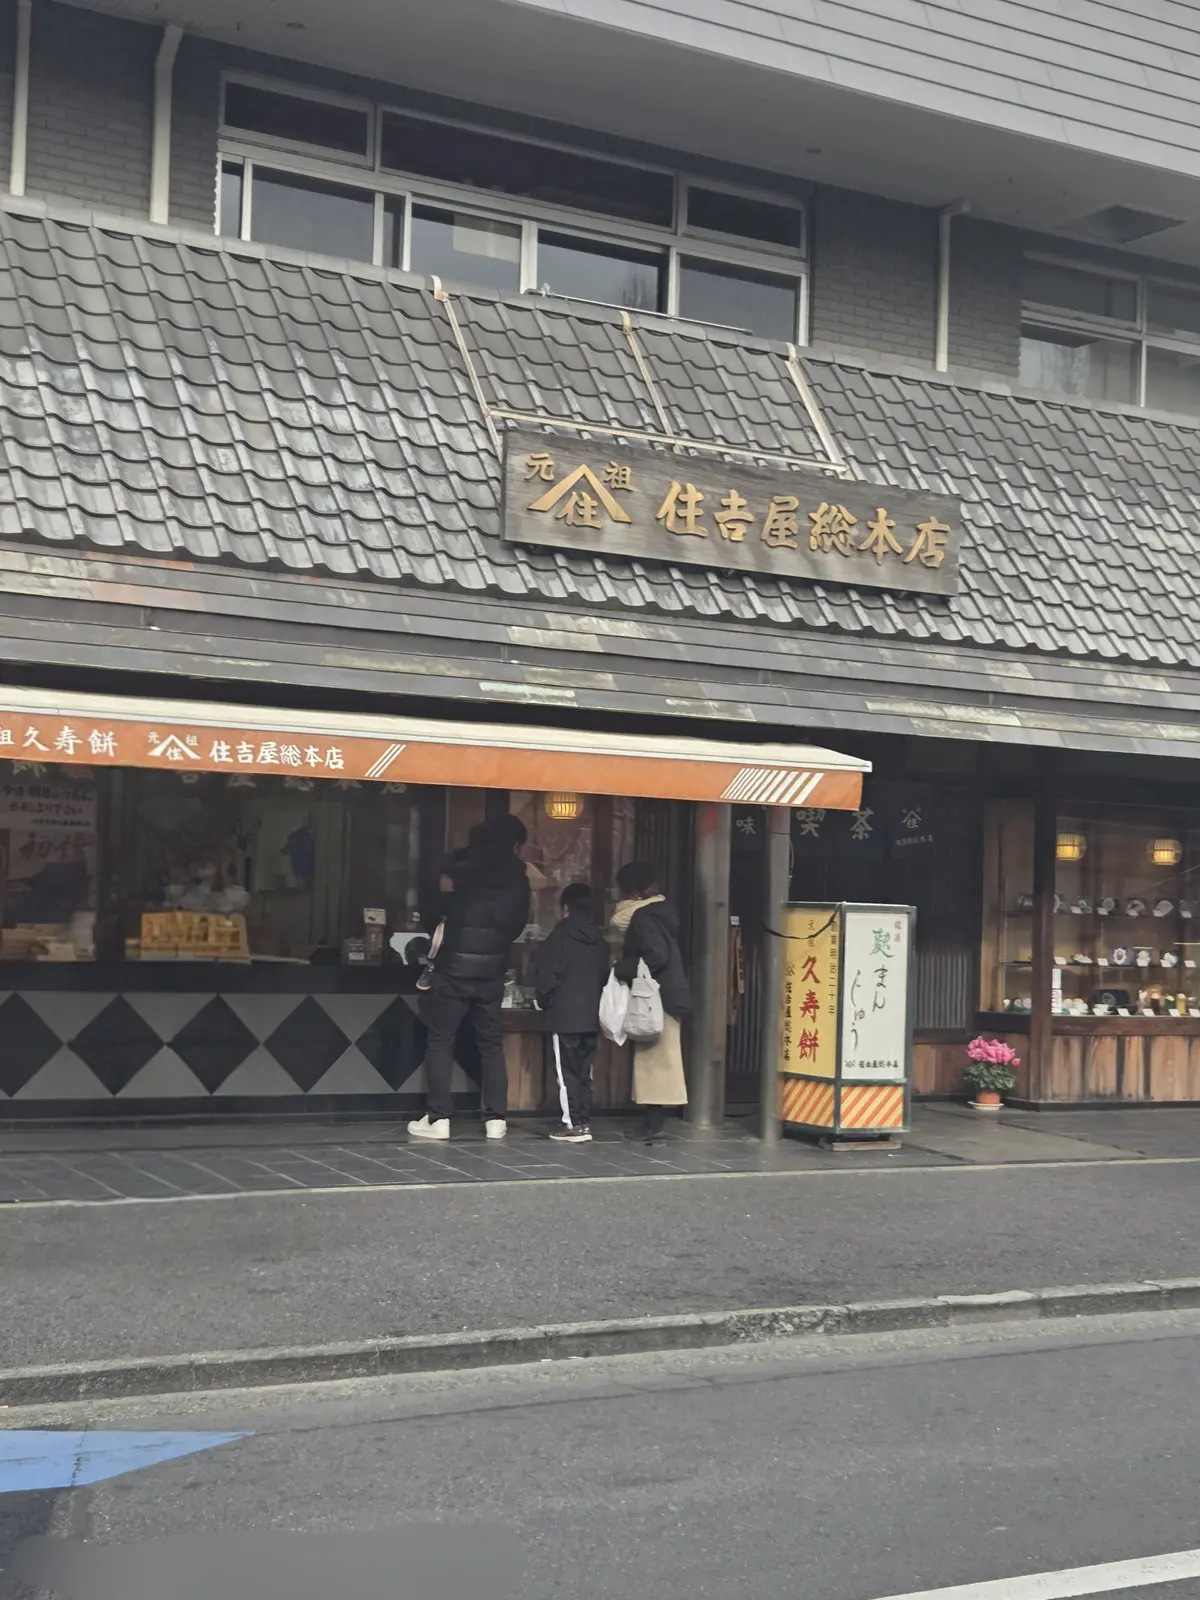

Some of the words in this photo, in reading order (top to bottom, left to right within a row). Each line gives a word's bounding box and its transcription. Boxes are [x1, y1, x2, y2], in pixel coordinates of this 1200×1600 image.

[655, 480, 953, 568] 住吉屋総本店
[208, 740, 345, 770] 住吉屋総本店
[797, 955, 821, 1063] 久寿餅
